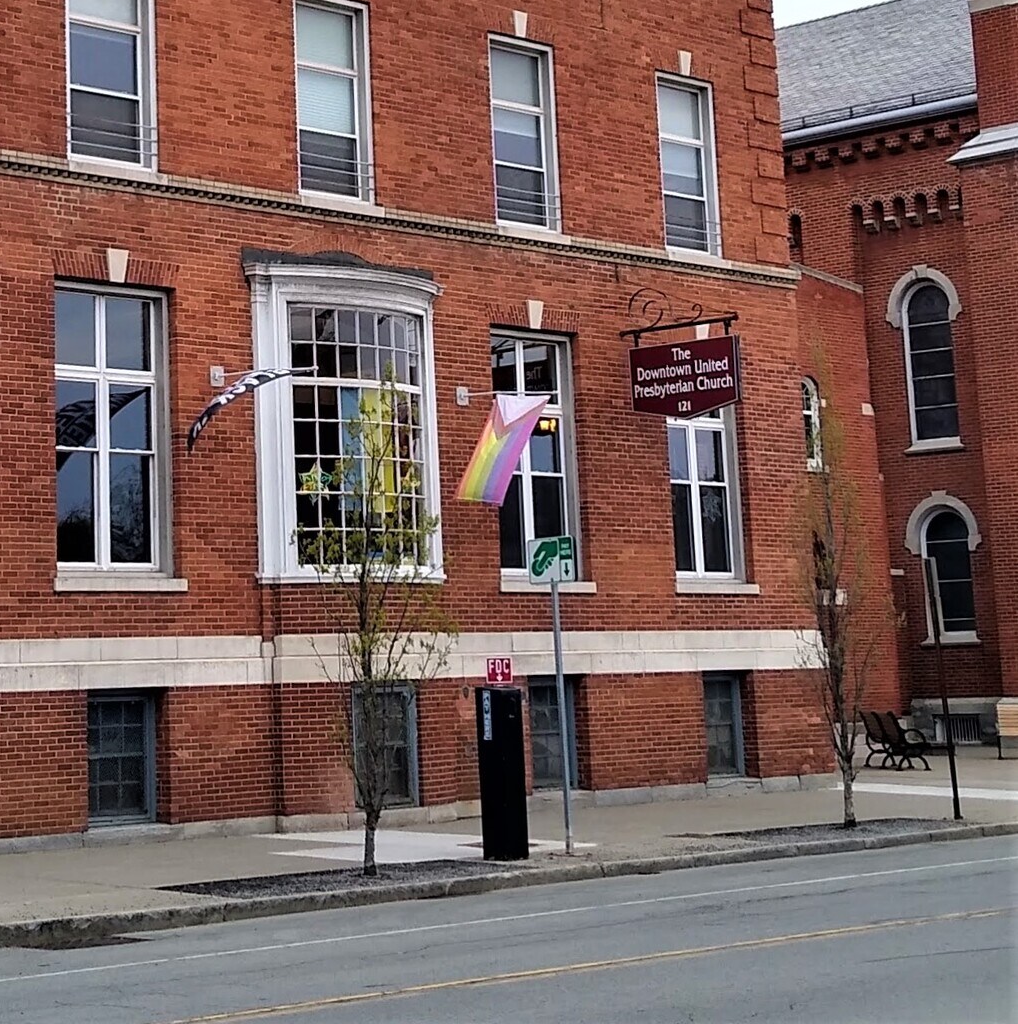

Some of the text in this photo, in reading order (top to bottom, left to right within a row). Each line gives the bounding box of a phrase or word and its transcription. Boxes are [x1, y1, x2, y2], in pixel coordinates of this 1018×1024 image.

[671, 348, 691, 361] The
[637, 357, 728, 381] Downtown United
[634, 374, 733, 399] Presbyterian Church
[678, 401, 691, 412] 121
[489, 659, 509, 674] FDC
